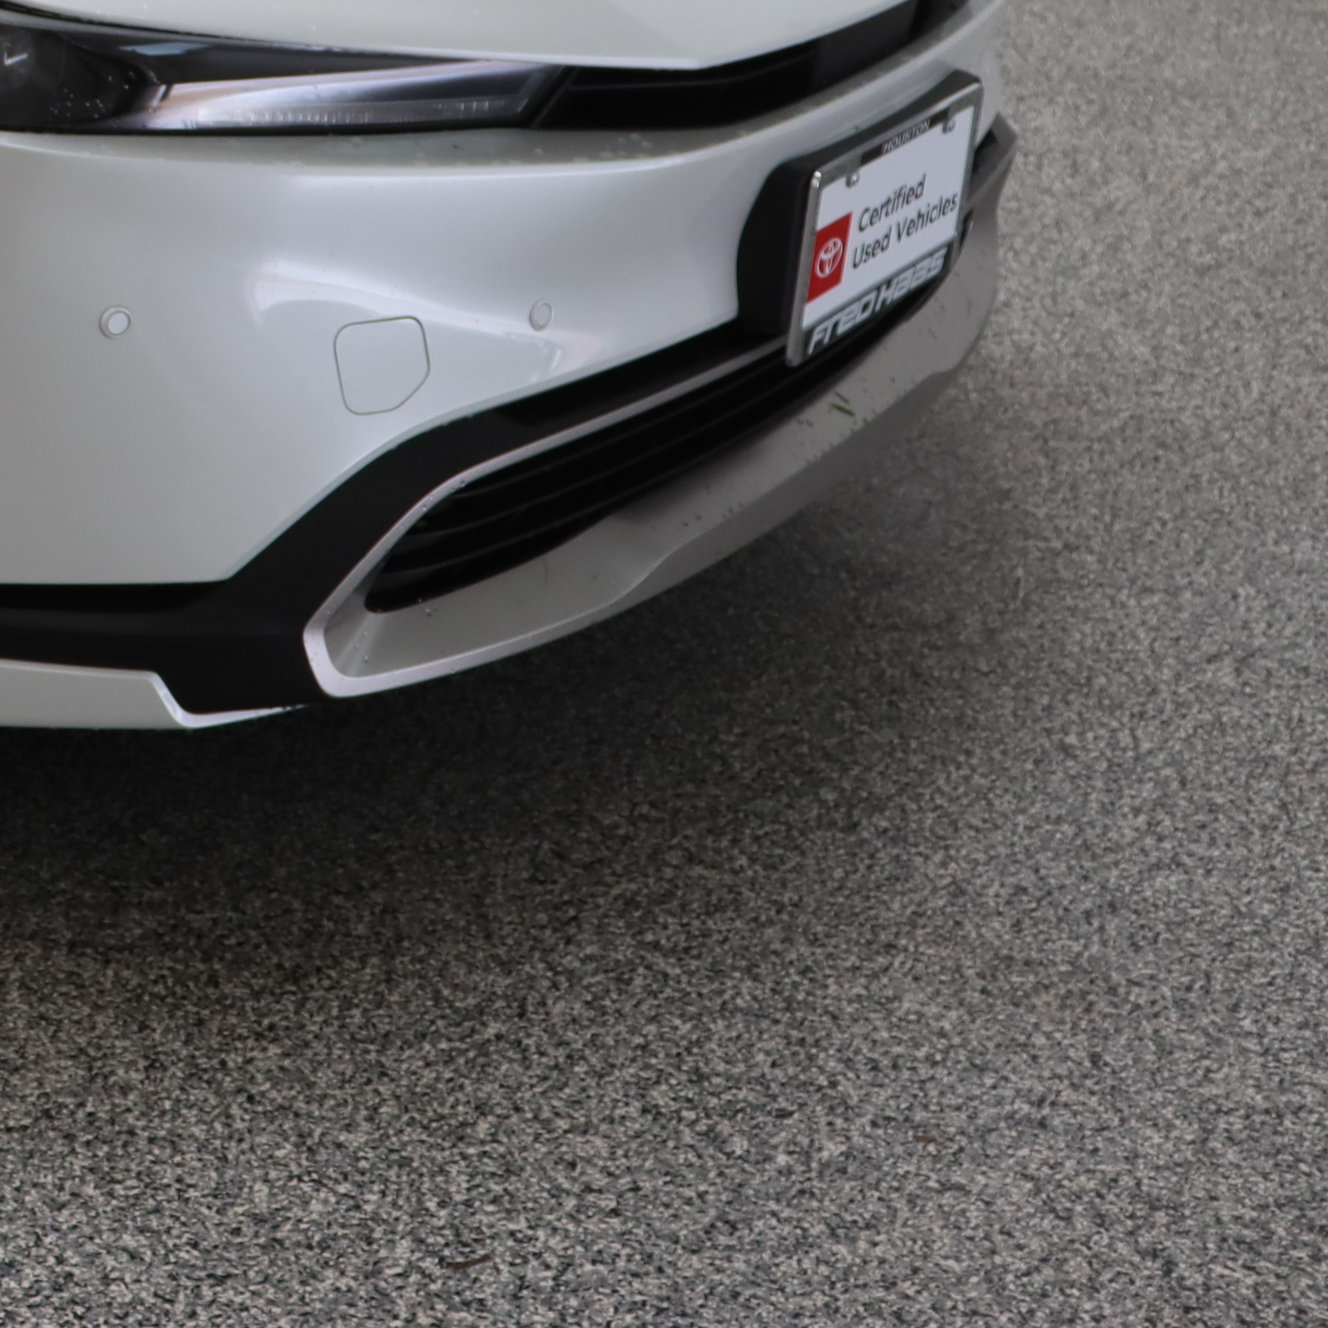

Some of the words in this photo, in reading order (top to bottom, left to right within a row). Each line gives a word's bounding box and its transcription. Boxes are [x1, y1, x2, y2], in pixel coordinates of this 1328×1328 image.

[852, 228, 892, 269] Used
[895, 192, 958, 243] Vehicles
[858, 173, 927, 233] Certified
